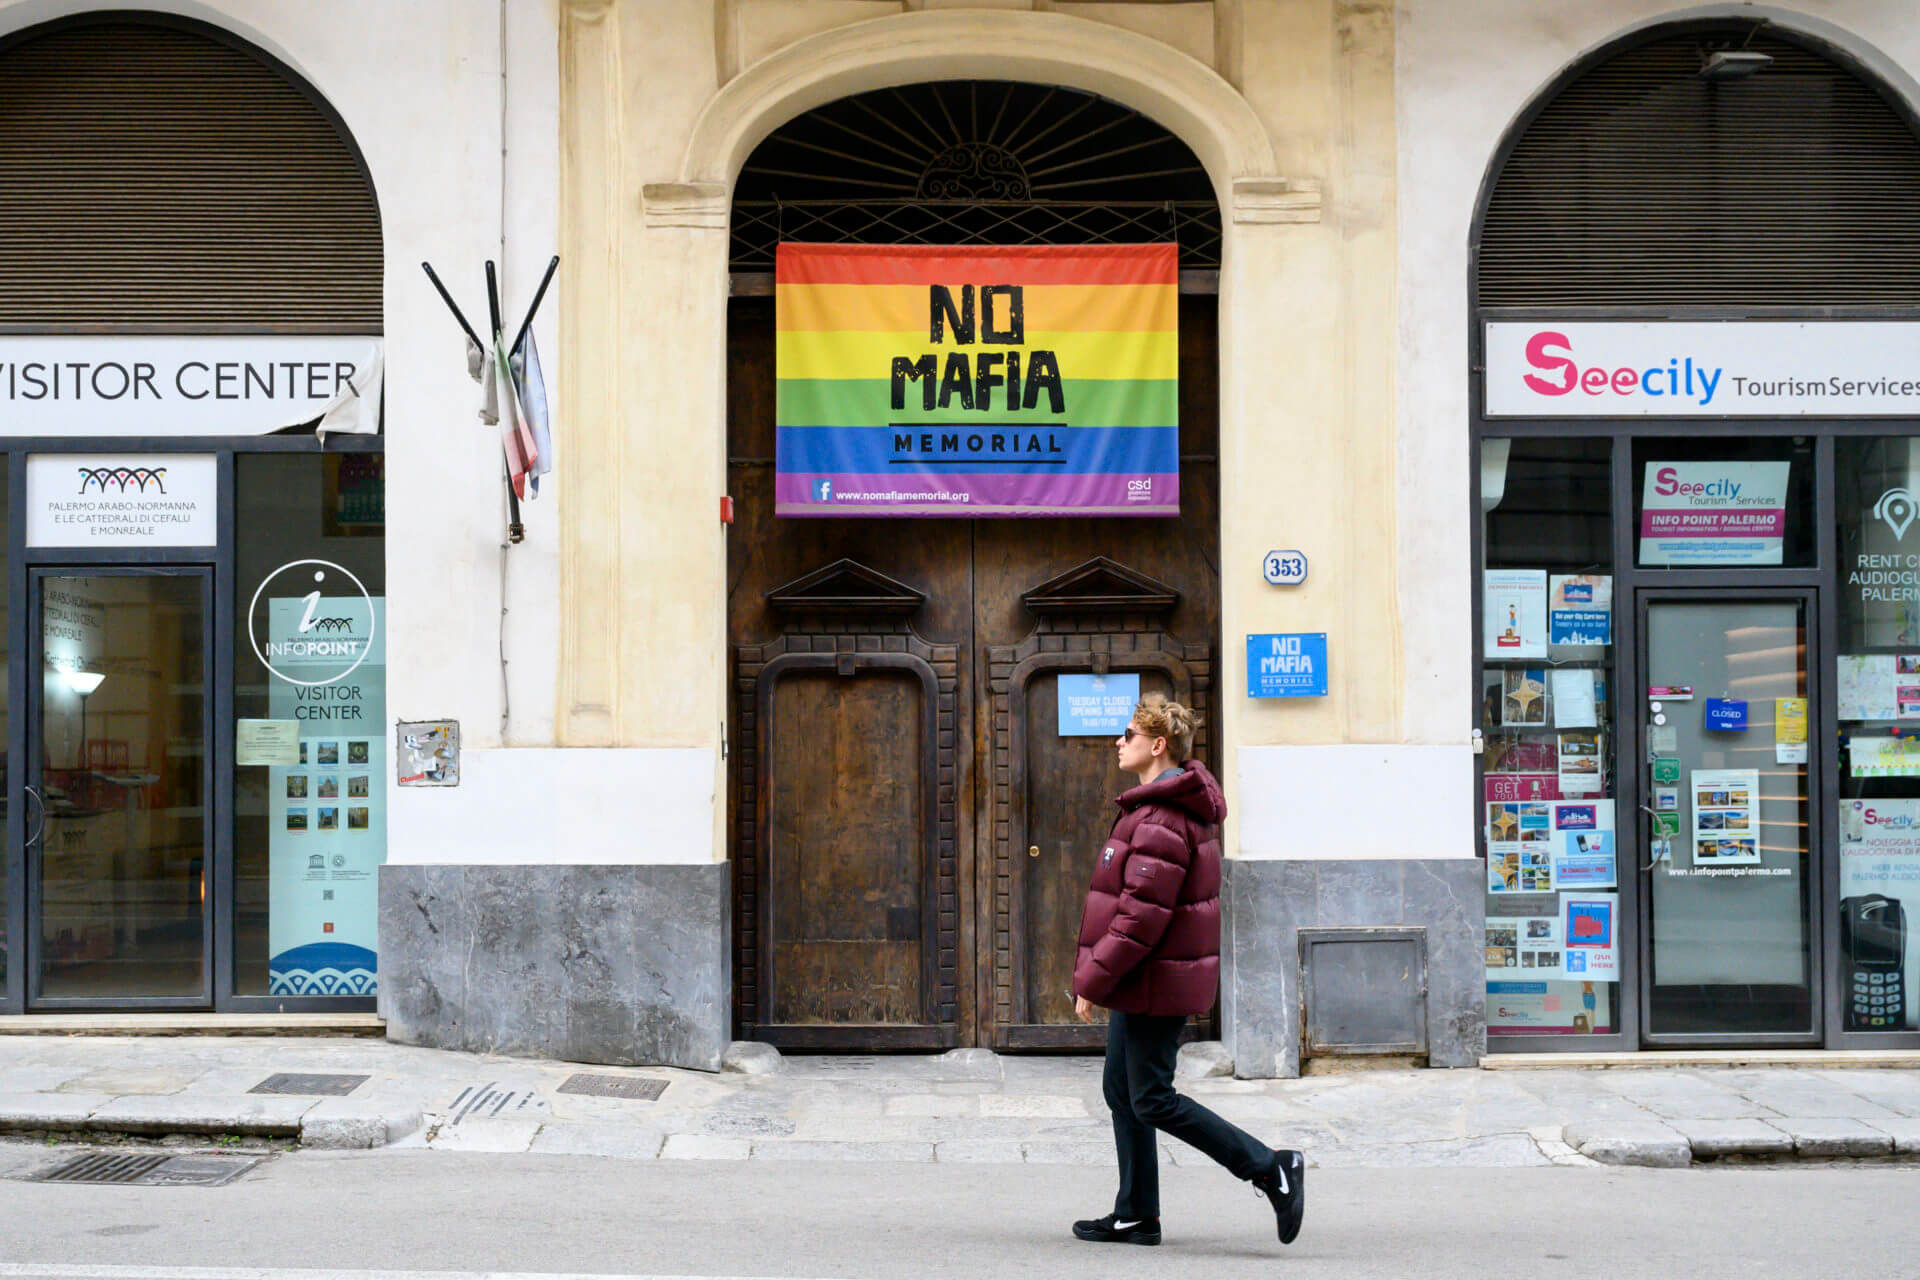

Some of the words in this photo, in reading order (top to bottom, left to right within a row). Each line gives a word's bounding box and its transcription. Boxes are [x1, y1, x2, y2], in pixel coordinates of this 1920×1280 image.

[930, 284, 1025, 345] NO
[1523, 331, 1722, 406] Seecily
[175, 361, 360, 400] CENTER
[890, 350, 1066, 414] MAFIA
[894, 434, 1062, 453] MEMORIAL
[1127, 477, 1152, 490] csd
[1654, 467, 1742, 499] Seecily
[836, 490, 970, 503] www.nomafiamemorial.org
[1689, 496, 1727, 505] Tourism
[1735, 496, 1776, 505] Services
[48, 501, 96, 511] PALERMO
[98, 501, 196, 511] ARABO-NORMANNA
[54, 514, 61, 523] E
[63, 514, 75, 523] LE
[77, 514, 138, 523] CATTEDRALI
[139, 514, 150, 523] DI
[1652, 515, 1681, 526] INFO
[1682, 515, 1718, 525] POINT
[1720, 514, 1776, 525] PALERMO
[91, 526, 97, 536] E
[99, 526, 155, 536] MONREALE
[1269, 558, 1302, 577] 353
[1858, 554, 1902, 568] RENT
[1906, 554, 1920, 568] C
[266, 641, 359, 656] INFOPOINT
[1271, 636, 1301, 656] NO
[1260, 655, 1313, 674] MAFIA
[1261, 677, 1313, 685] MEMORIAL
[295, 686, 362, 701] VISITOR
[294, 705, 362, 720] CENTER
[1711, 710, 1741, 719] CLOSED
[1494, 782, 1519, 794] GET
[1864, 808, 1913, 827] Seecily
